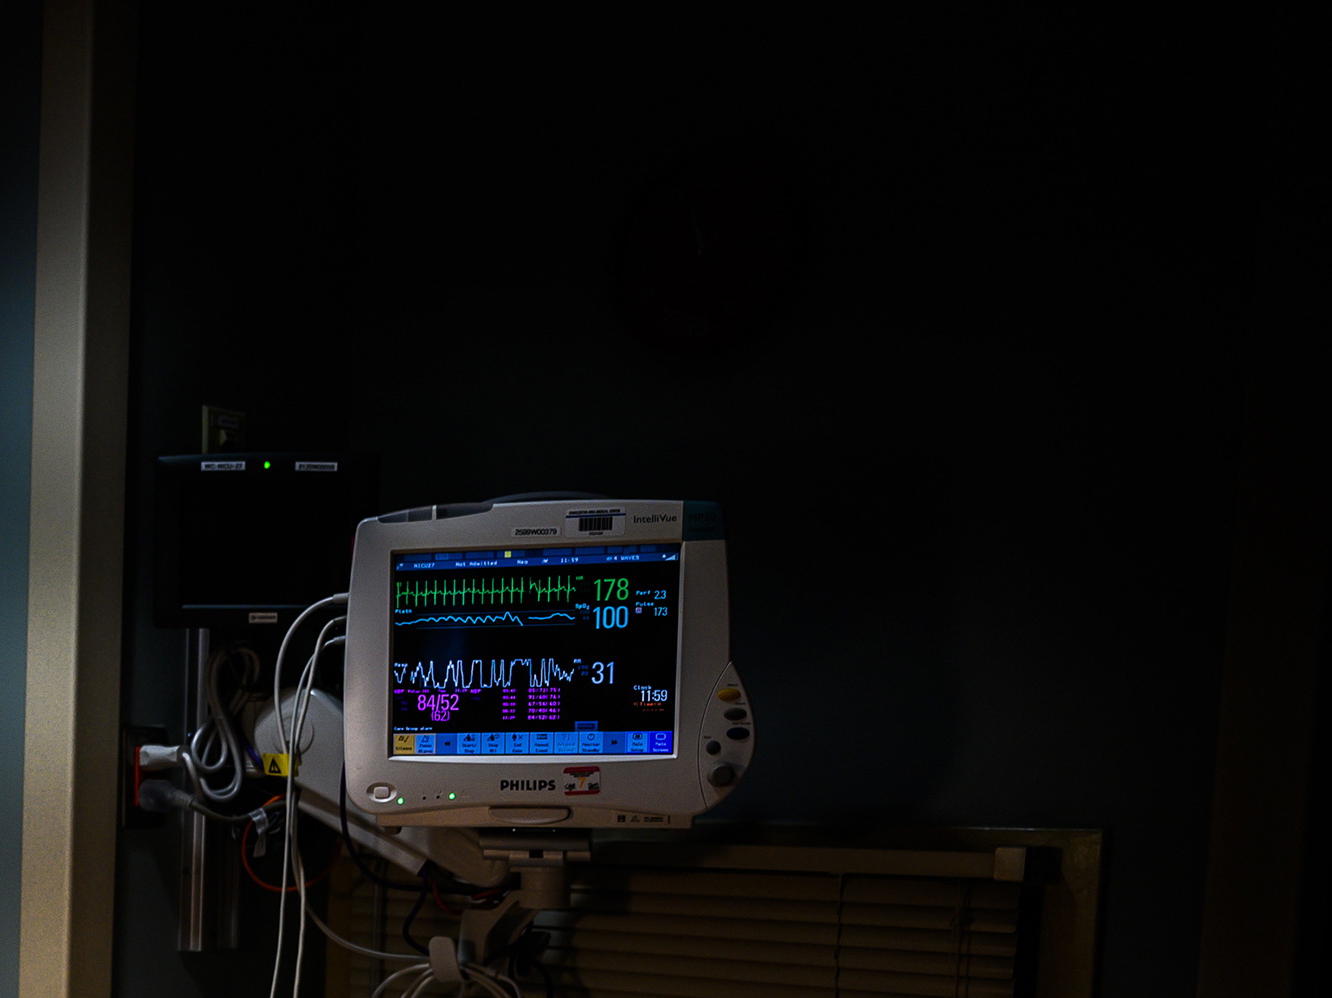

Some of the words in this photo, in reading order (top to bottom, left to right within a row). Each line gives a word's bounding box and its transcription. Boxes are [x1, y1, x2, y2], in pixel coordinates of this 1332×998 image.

[634, 515, 677, 524] IntelliVue
[594, 578, 629, 601] 178
[654, 590, 666, 599] 2.3
[654, 607, 667, 616] 173
[593, 606, 628, 629] 100
[591, 662, 614, 684] 31
[641, 690, 668, 702] 11:59
[418, 694, 459, 711] 84/52
[431, 710, 450, 721] (62)
[500, 780, 556, 791] PHILIPS
